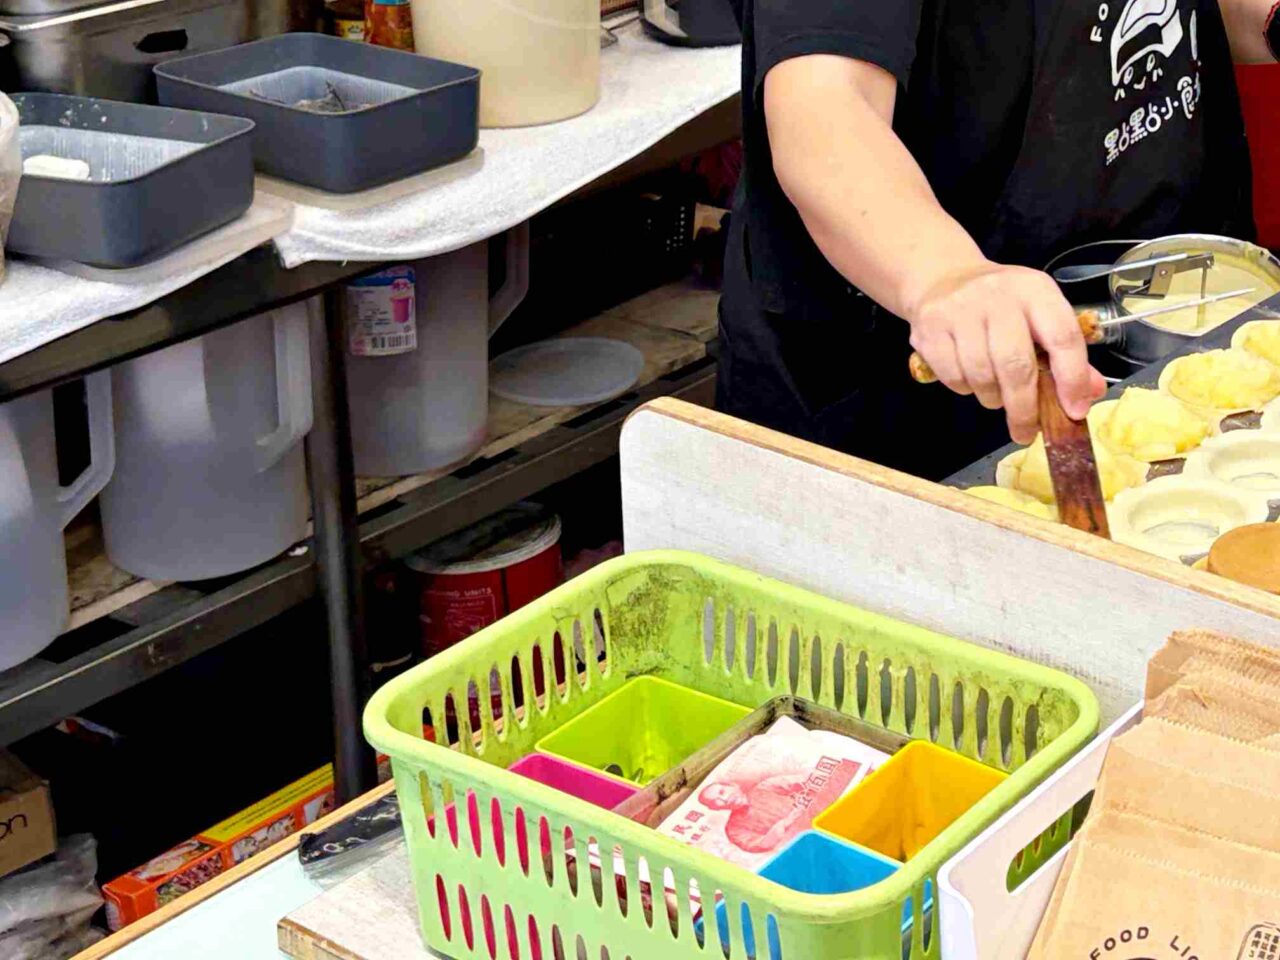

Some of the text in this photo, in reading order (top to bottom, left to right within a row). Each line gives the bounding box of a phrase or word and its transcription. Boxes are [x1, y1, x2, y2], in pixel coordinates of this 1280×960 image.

[1103, 75, 1200, 166] 點點小食
[1089, 926, 1149, 960] FOOD
